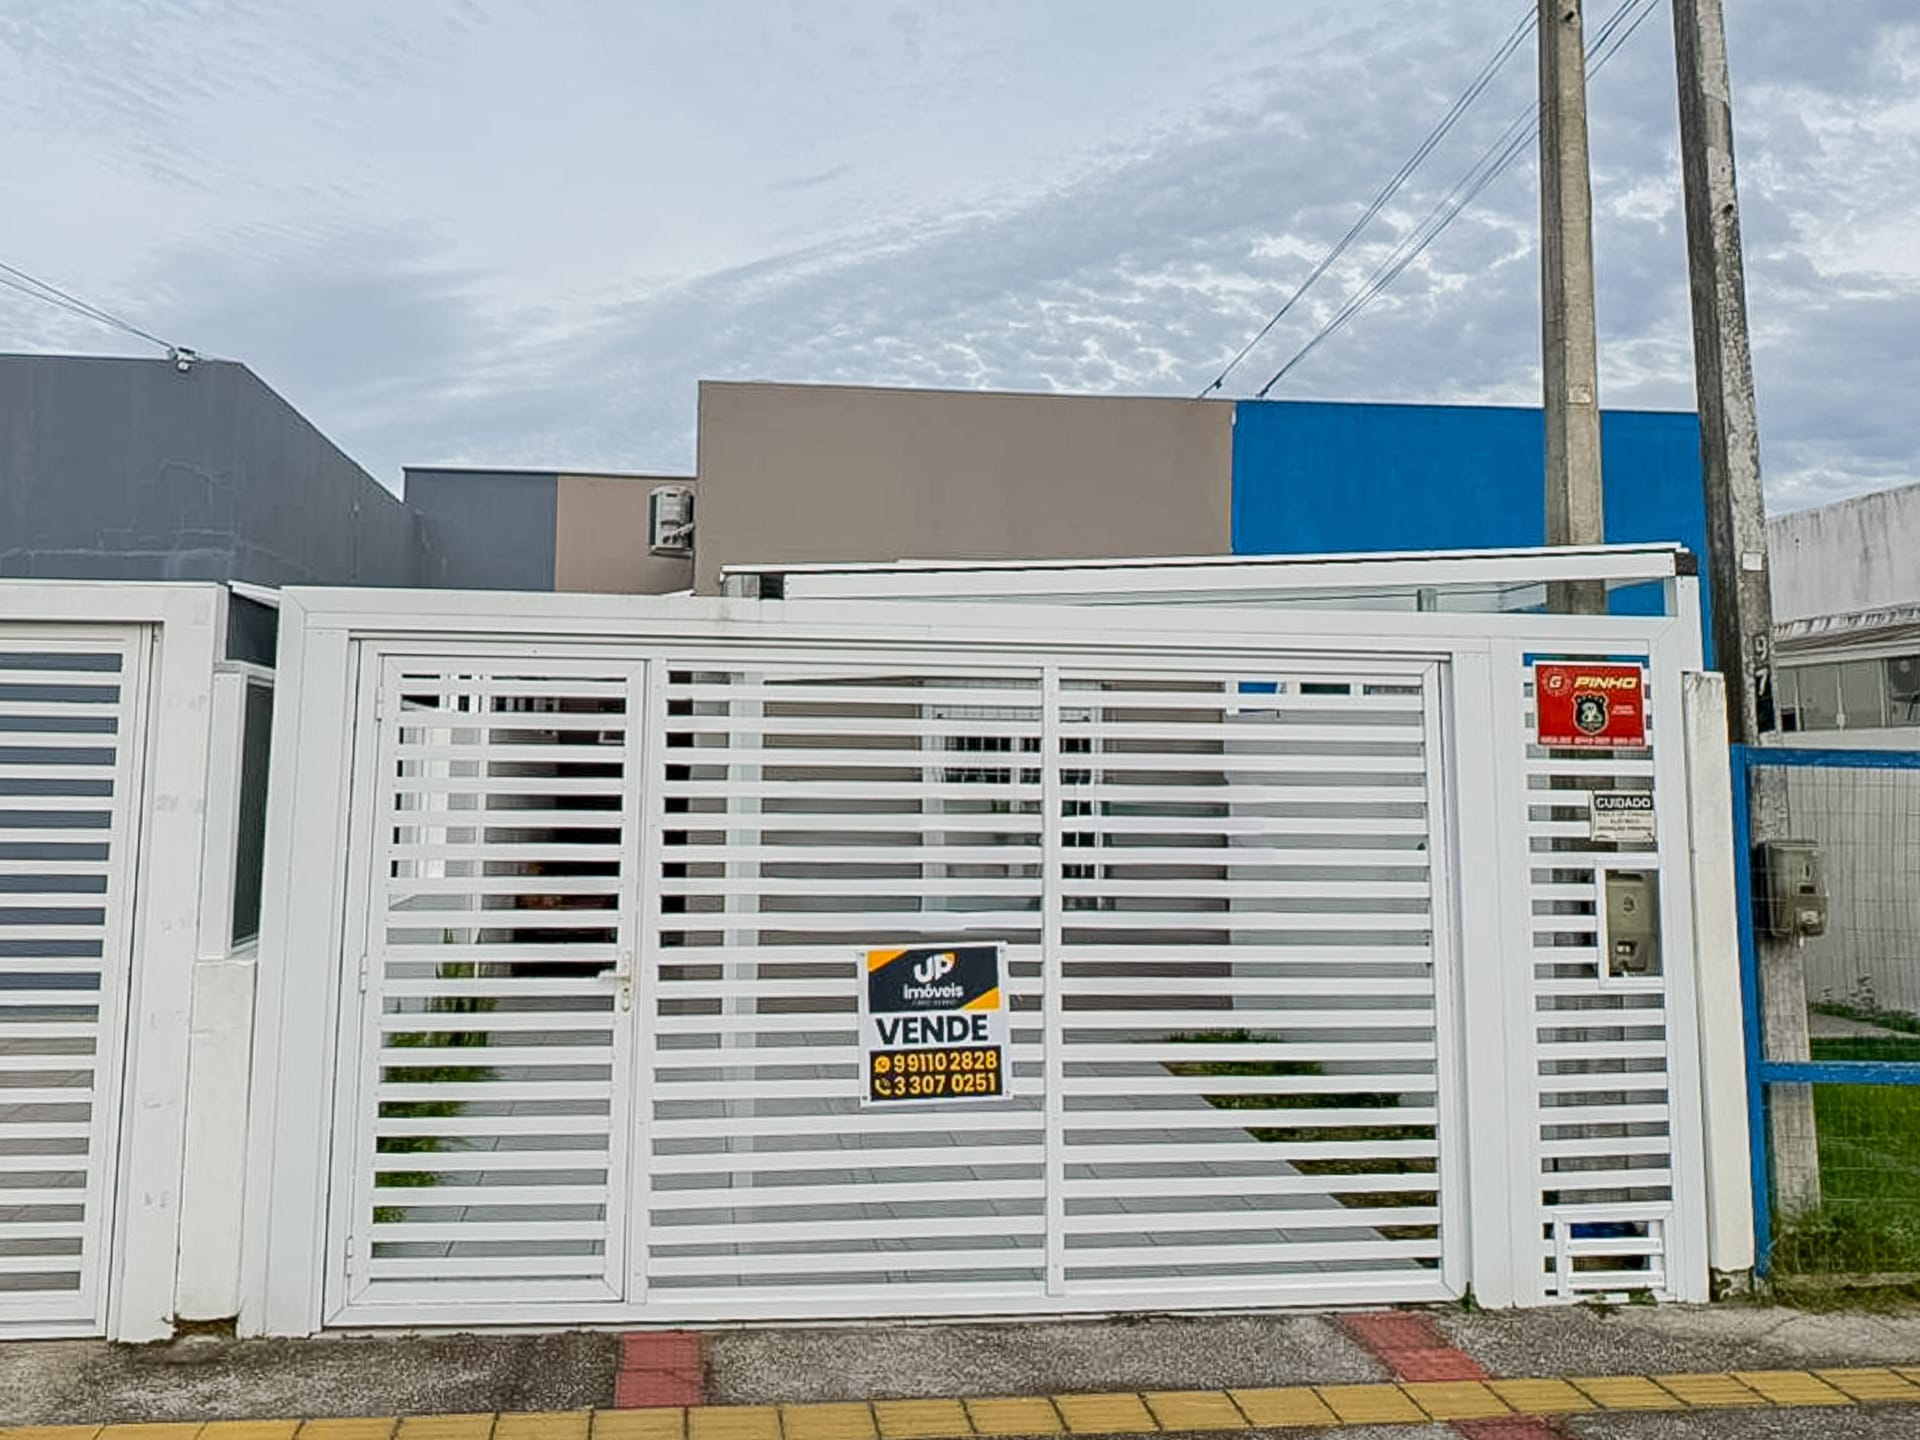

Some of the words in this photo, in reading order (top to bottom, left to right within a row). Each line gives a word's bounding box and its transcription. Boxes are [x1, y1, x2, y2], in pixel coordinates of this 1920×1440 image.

[1573, 676, 1638, 689] PINHO
[1596, 797, 1651, 808] CUIDADO
[875, 1014, 988, 1045] VENDE
[949, 1050, 997, 1071] 2828
[951, 1072, 996, 1093] 0251
